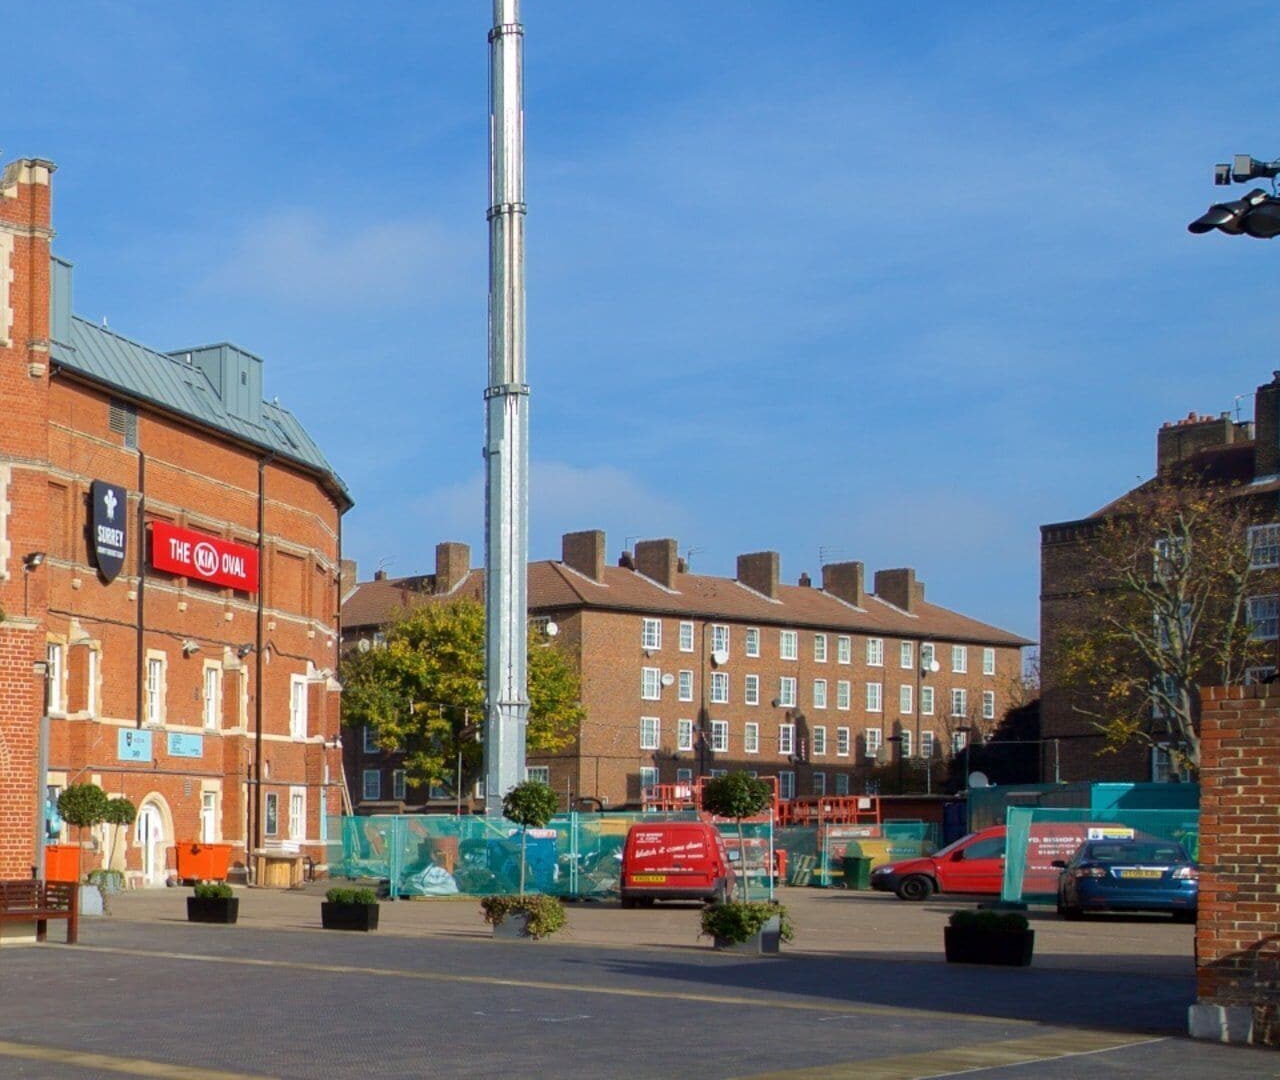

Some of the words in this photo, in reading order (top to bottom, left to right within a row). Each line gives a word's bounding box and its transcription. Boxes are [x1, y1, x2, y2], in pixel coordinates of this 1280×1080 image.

[97, 524, 124, 547] SURREY
[169, 538, 191, 564] THE
[222, 553, 246, 578] OVAL
